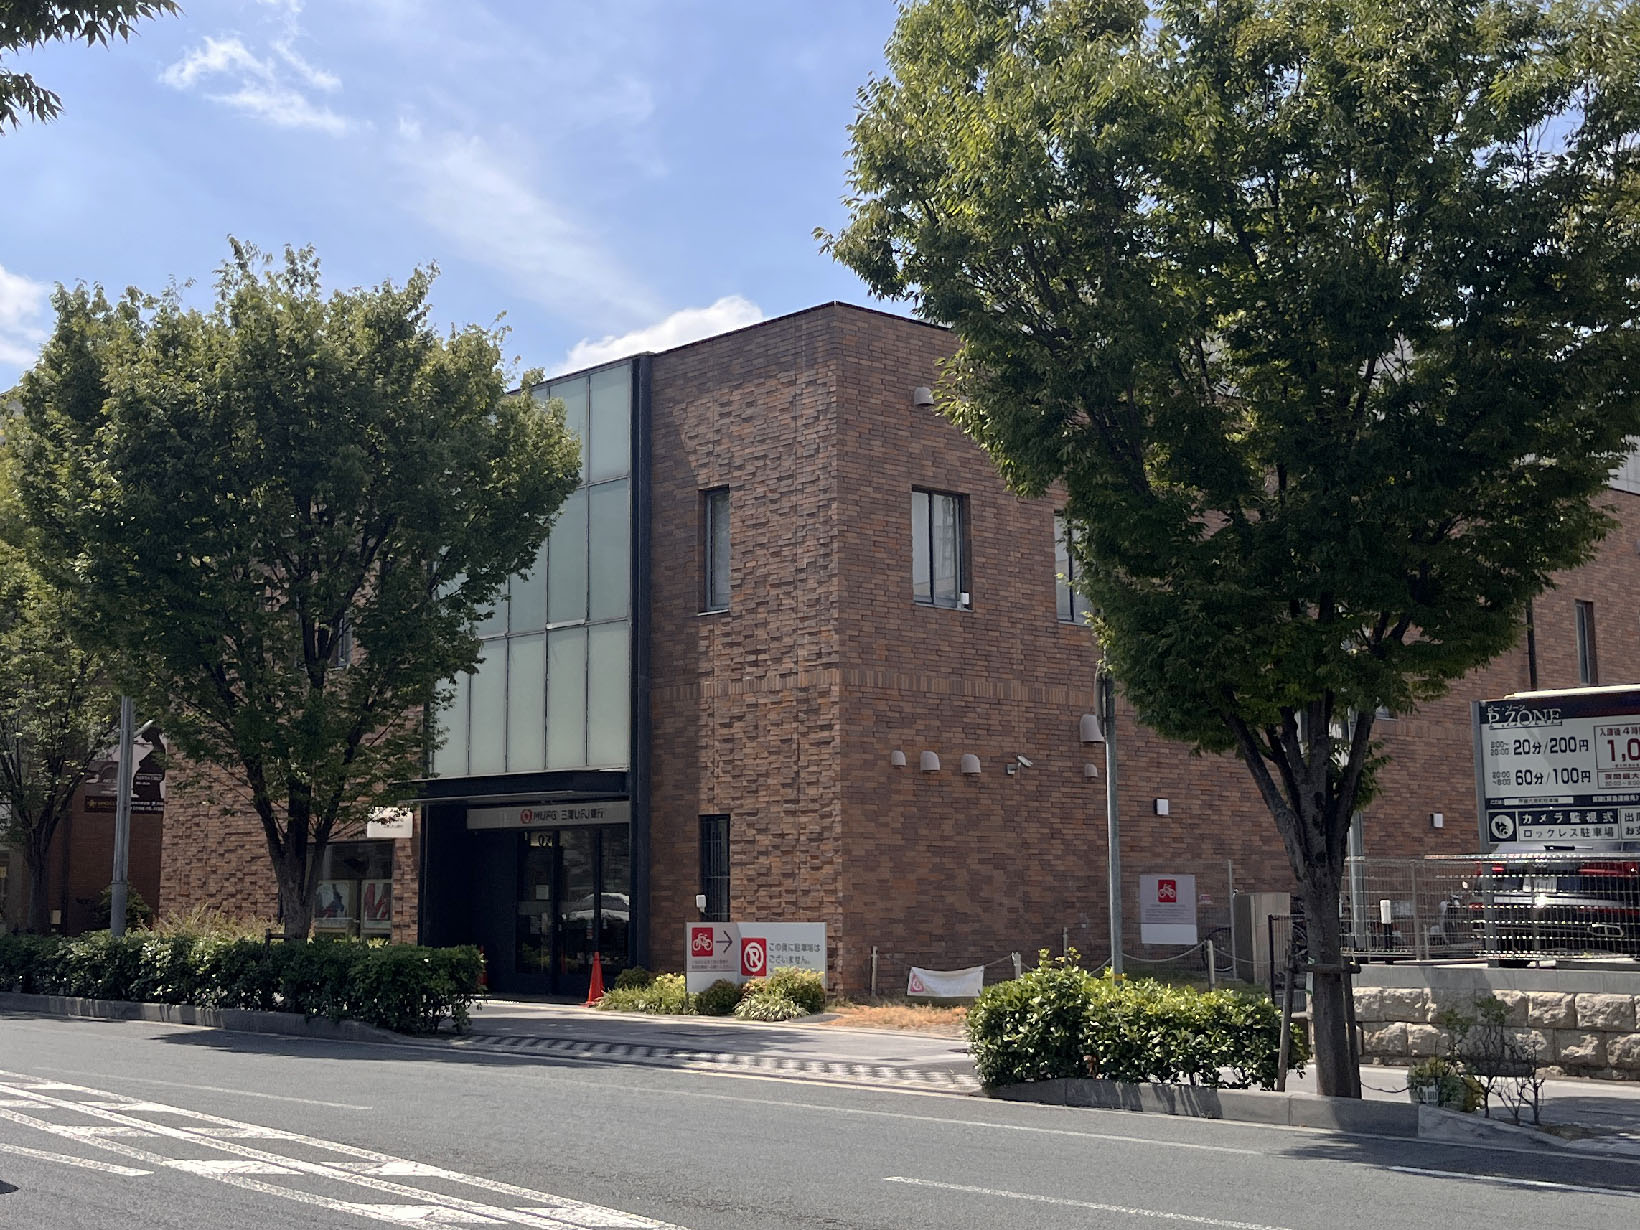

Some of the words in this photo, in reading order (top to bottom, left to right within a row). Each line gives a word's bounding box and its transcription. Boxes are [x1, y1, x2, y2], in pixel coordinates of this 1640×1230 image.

[1522, 811, 1614, 824] カメラ監視式
[1523, 827, 1614, 838] ロックレス駐車場
